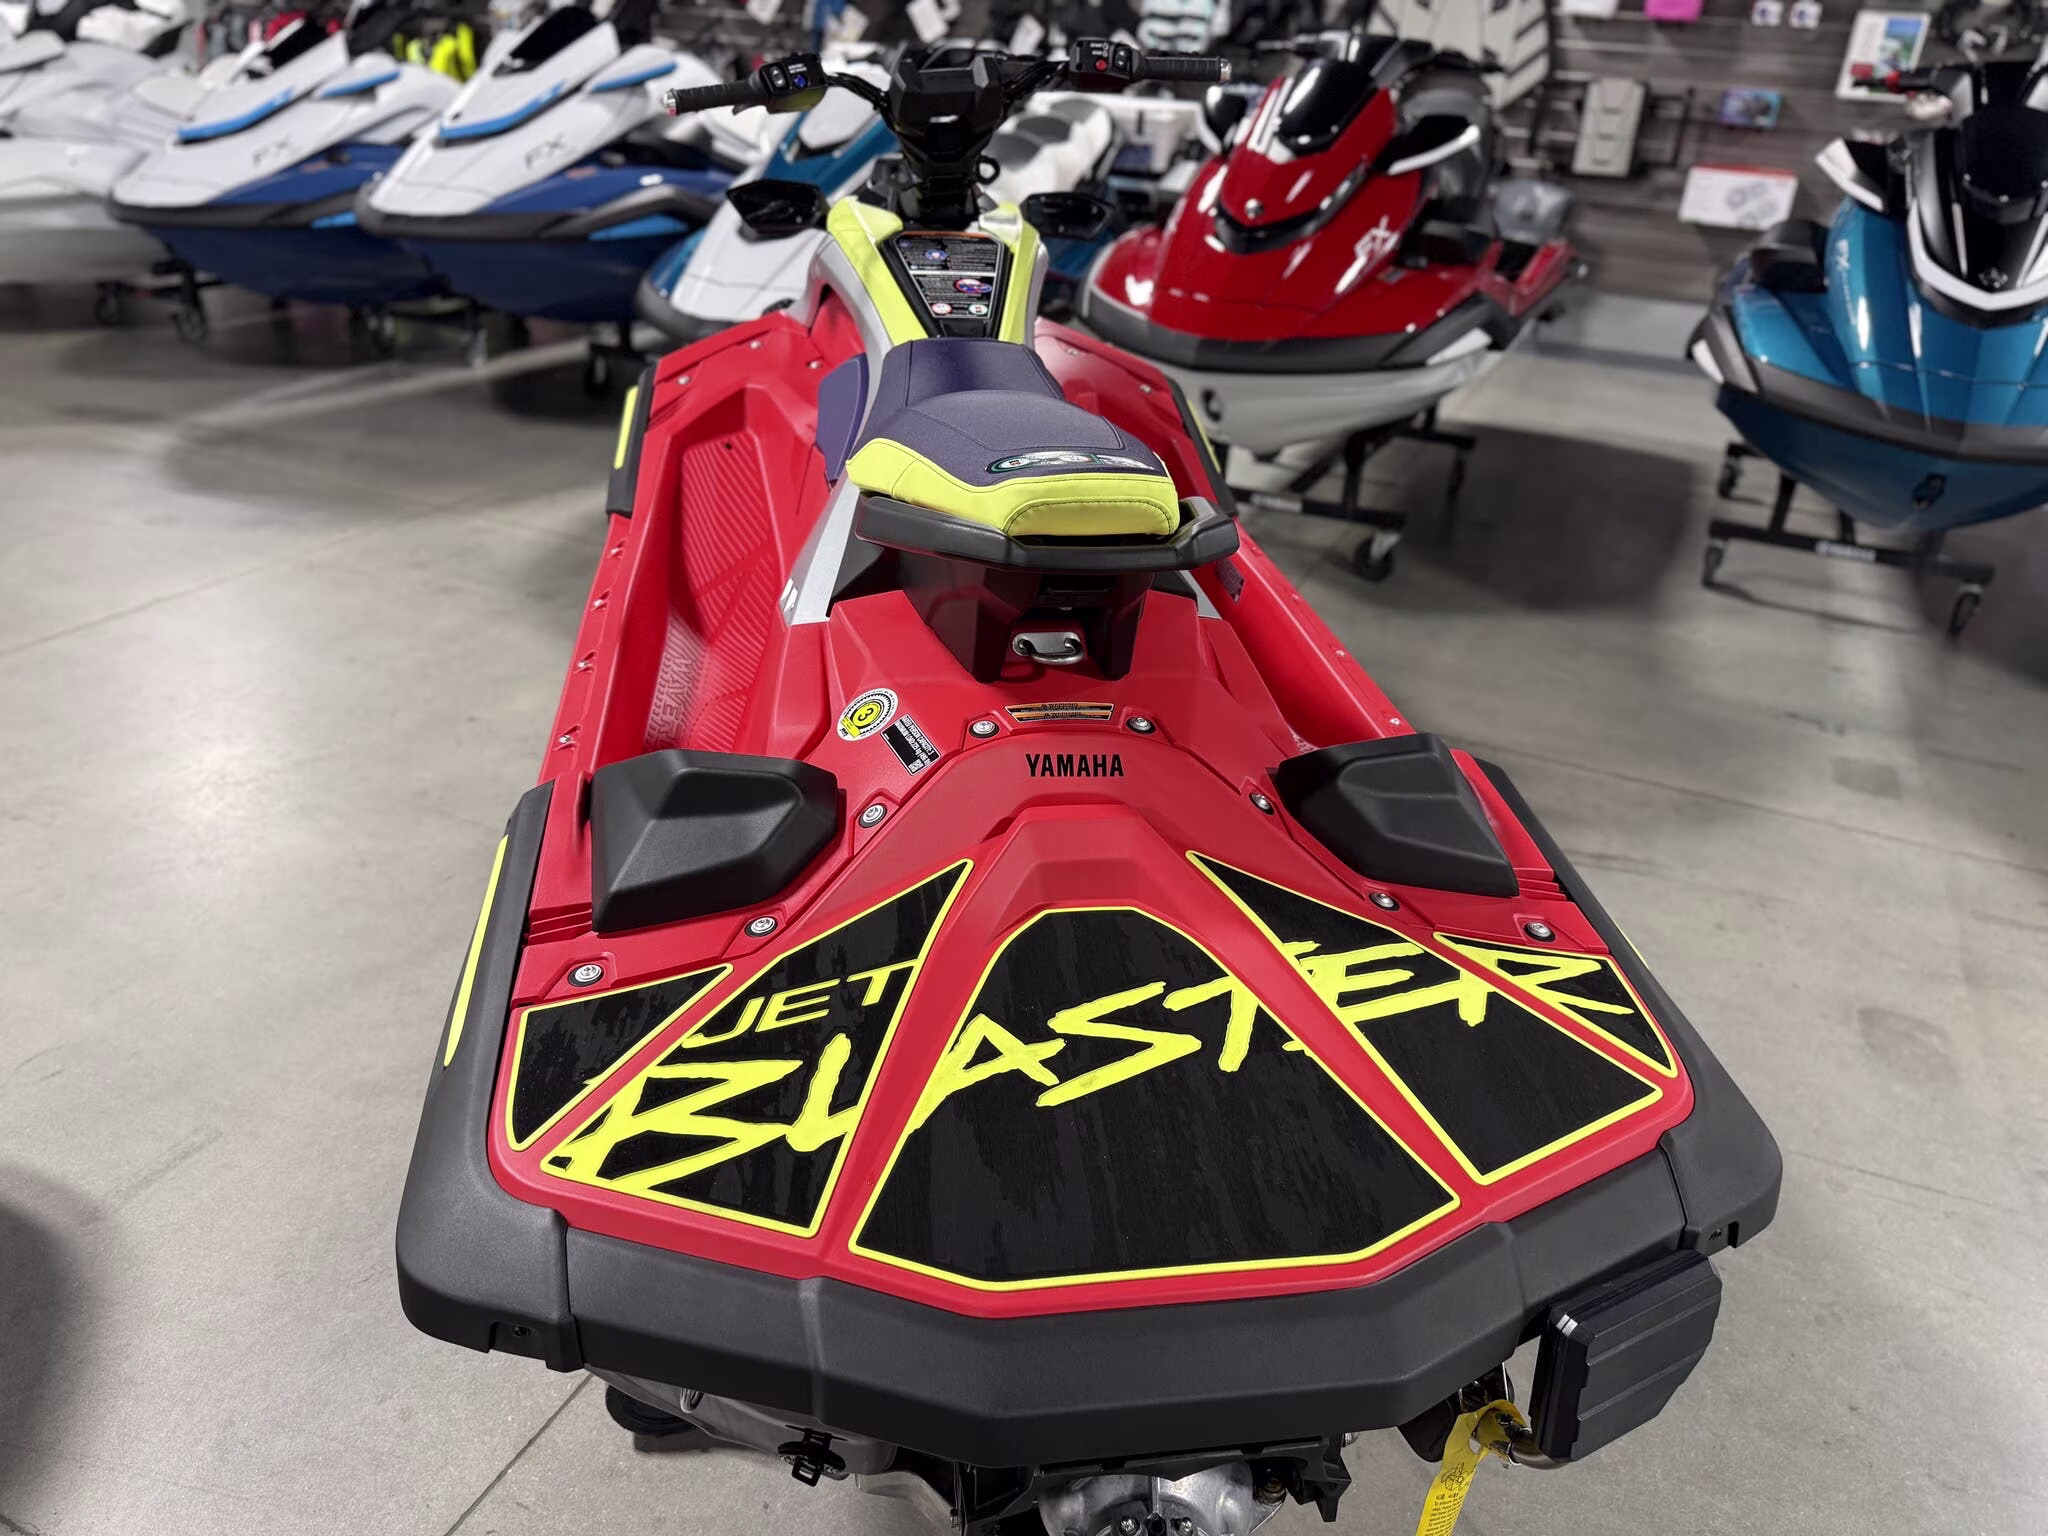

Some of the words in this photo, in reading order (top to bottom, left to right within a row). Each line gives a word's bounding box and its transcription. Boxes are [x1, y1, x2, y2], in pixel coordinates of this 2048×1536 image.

[857, 707, 875, 722] 3
[1025, 753, 1124, 777] YAMAHA
[681, 960, 916, 1049] JET
[562, 939, 1635, 1190] BLASTER
